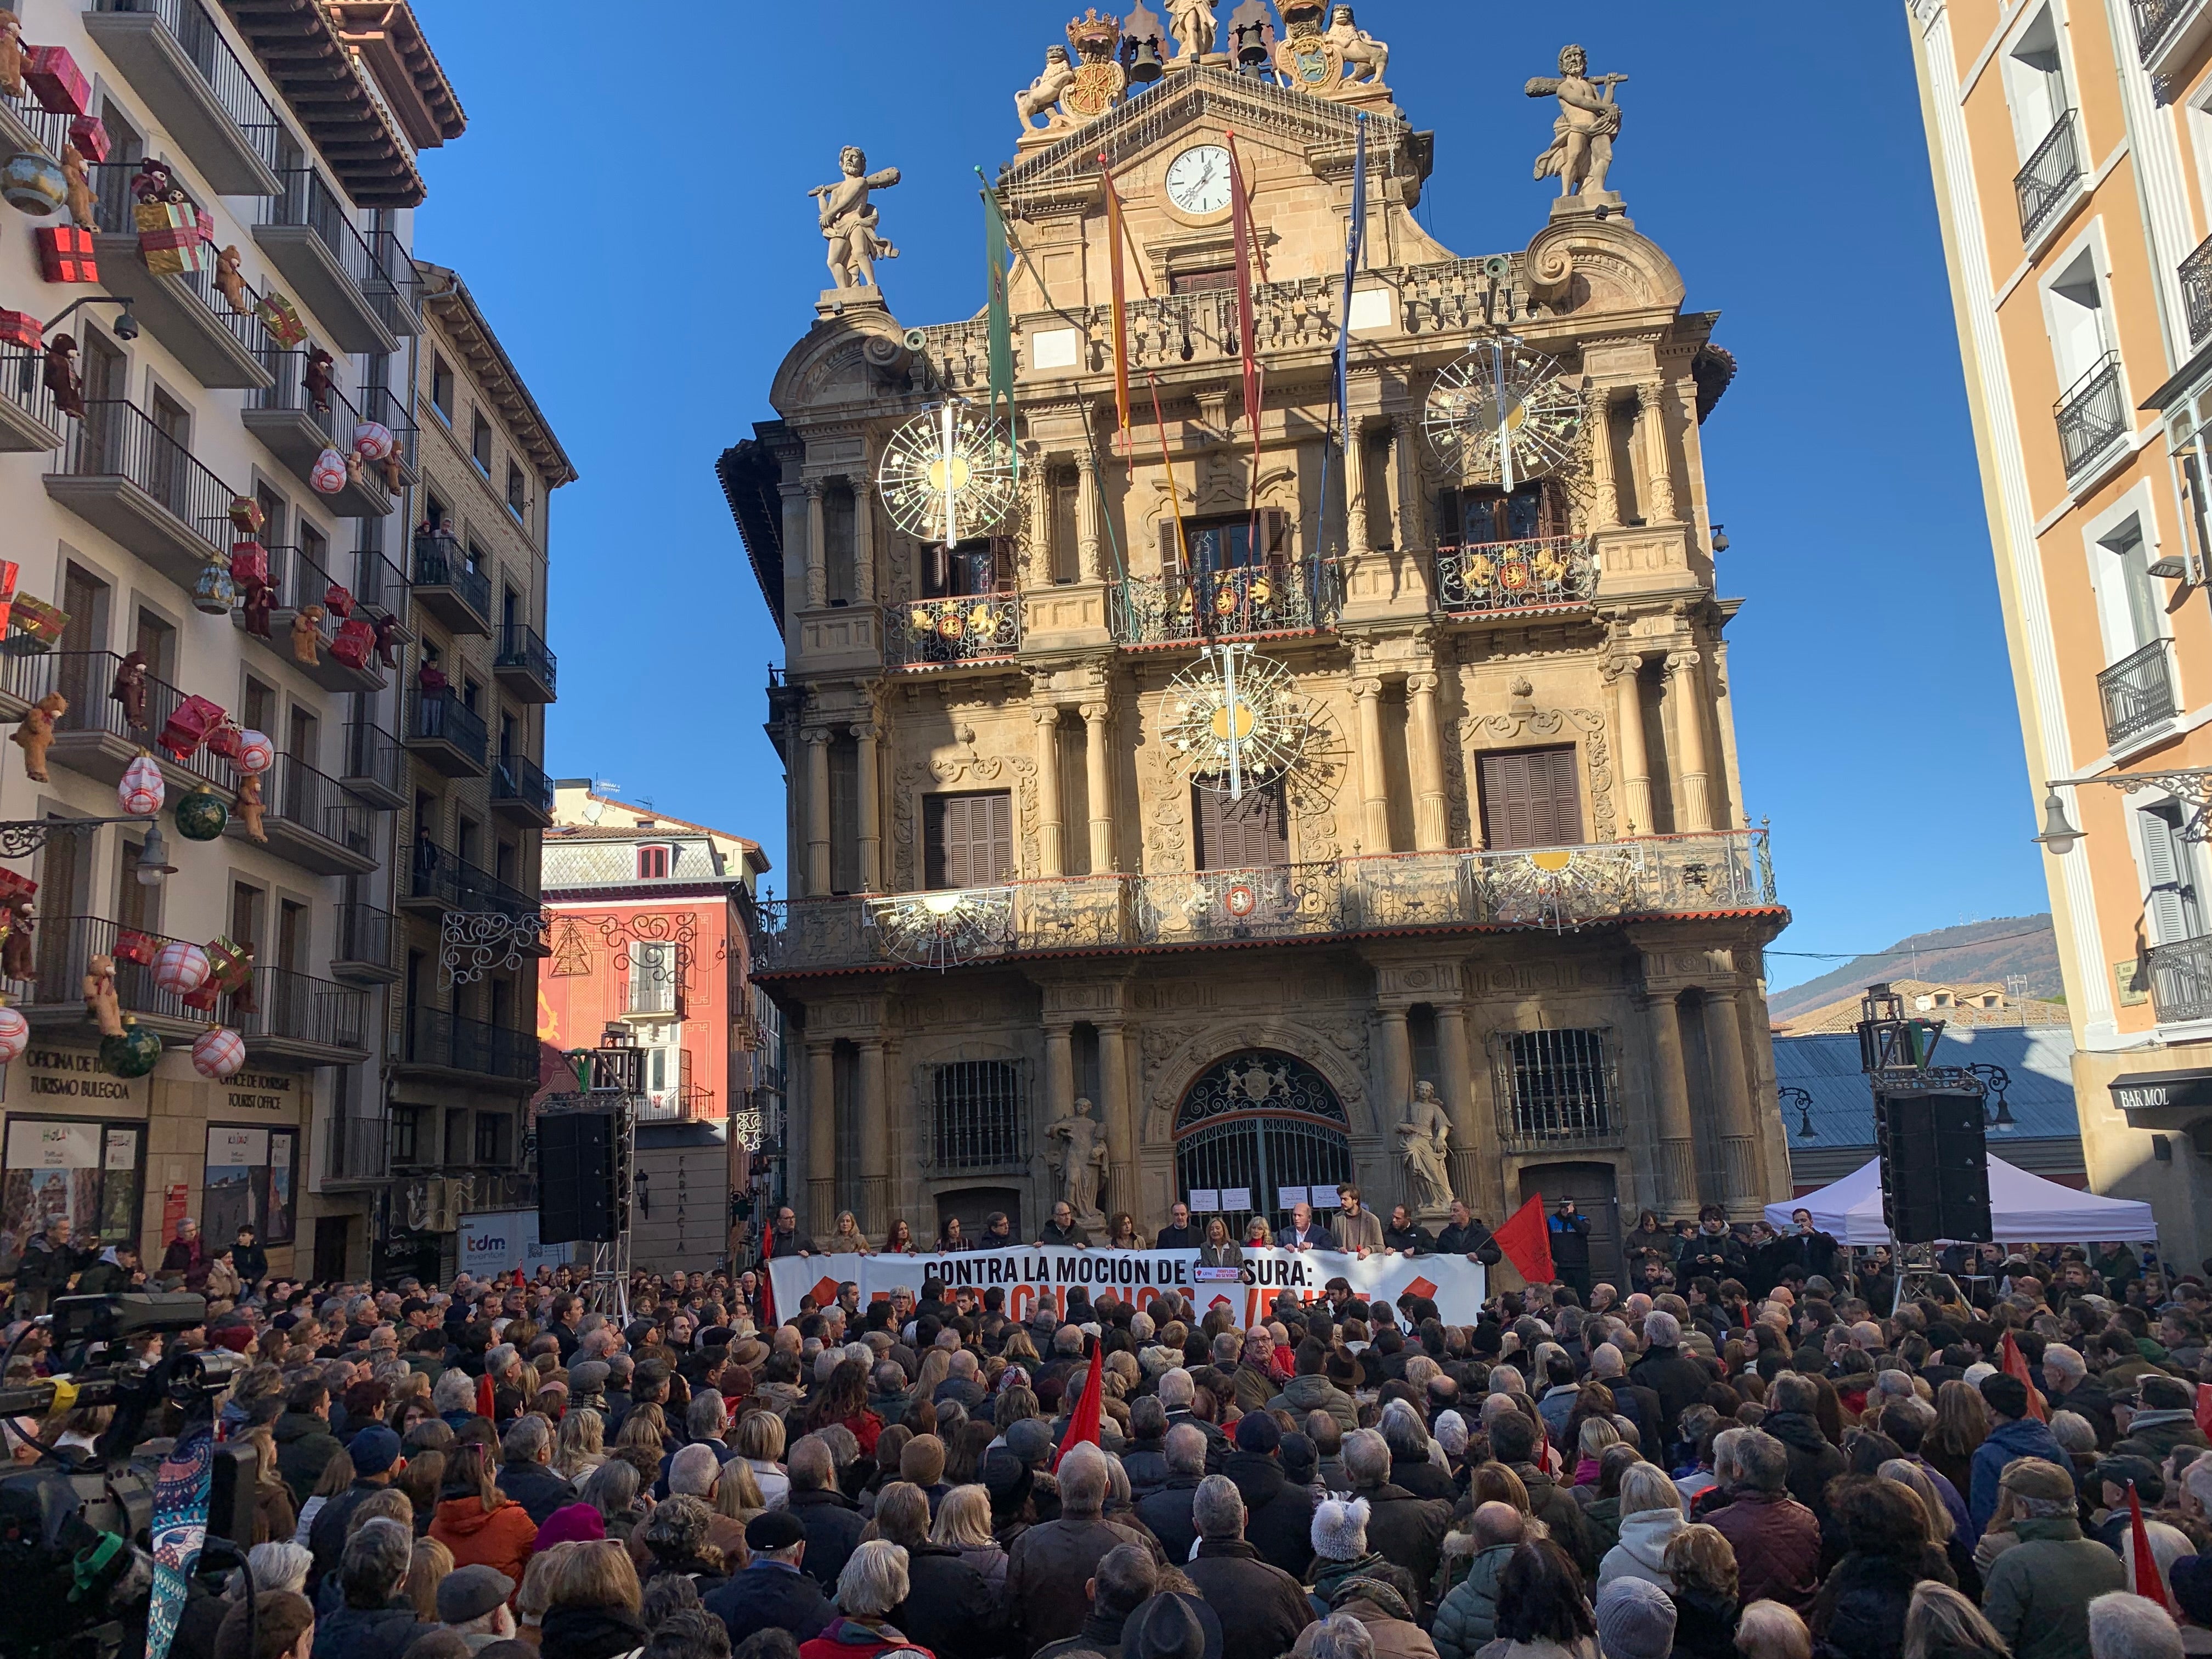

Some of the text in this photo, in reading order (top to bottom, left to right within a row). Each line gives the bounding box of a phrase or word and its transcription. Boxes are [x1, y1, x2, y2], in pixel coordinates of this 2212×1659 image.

[27, 1049, 74, 1070] OFICINA
[76, 1055, 91, 1072] DE
[30, 1075, 130, 1100] TURISMO BULEGOA
[247, 1074, 257, 1088] DE
[228, 1093, 281, 1110] TOURIST OFFICE
[2119, 1088, 2169, 1107] BAR MOL
[677, 1156, 686, 1252] FARMACIA
[466, 1251, 506, 1260] eventos
[924, 1254, 1312, 1287] CONTRA LA MOCIÓN DE SURA:
